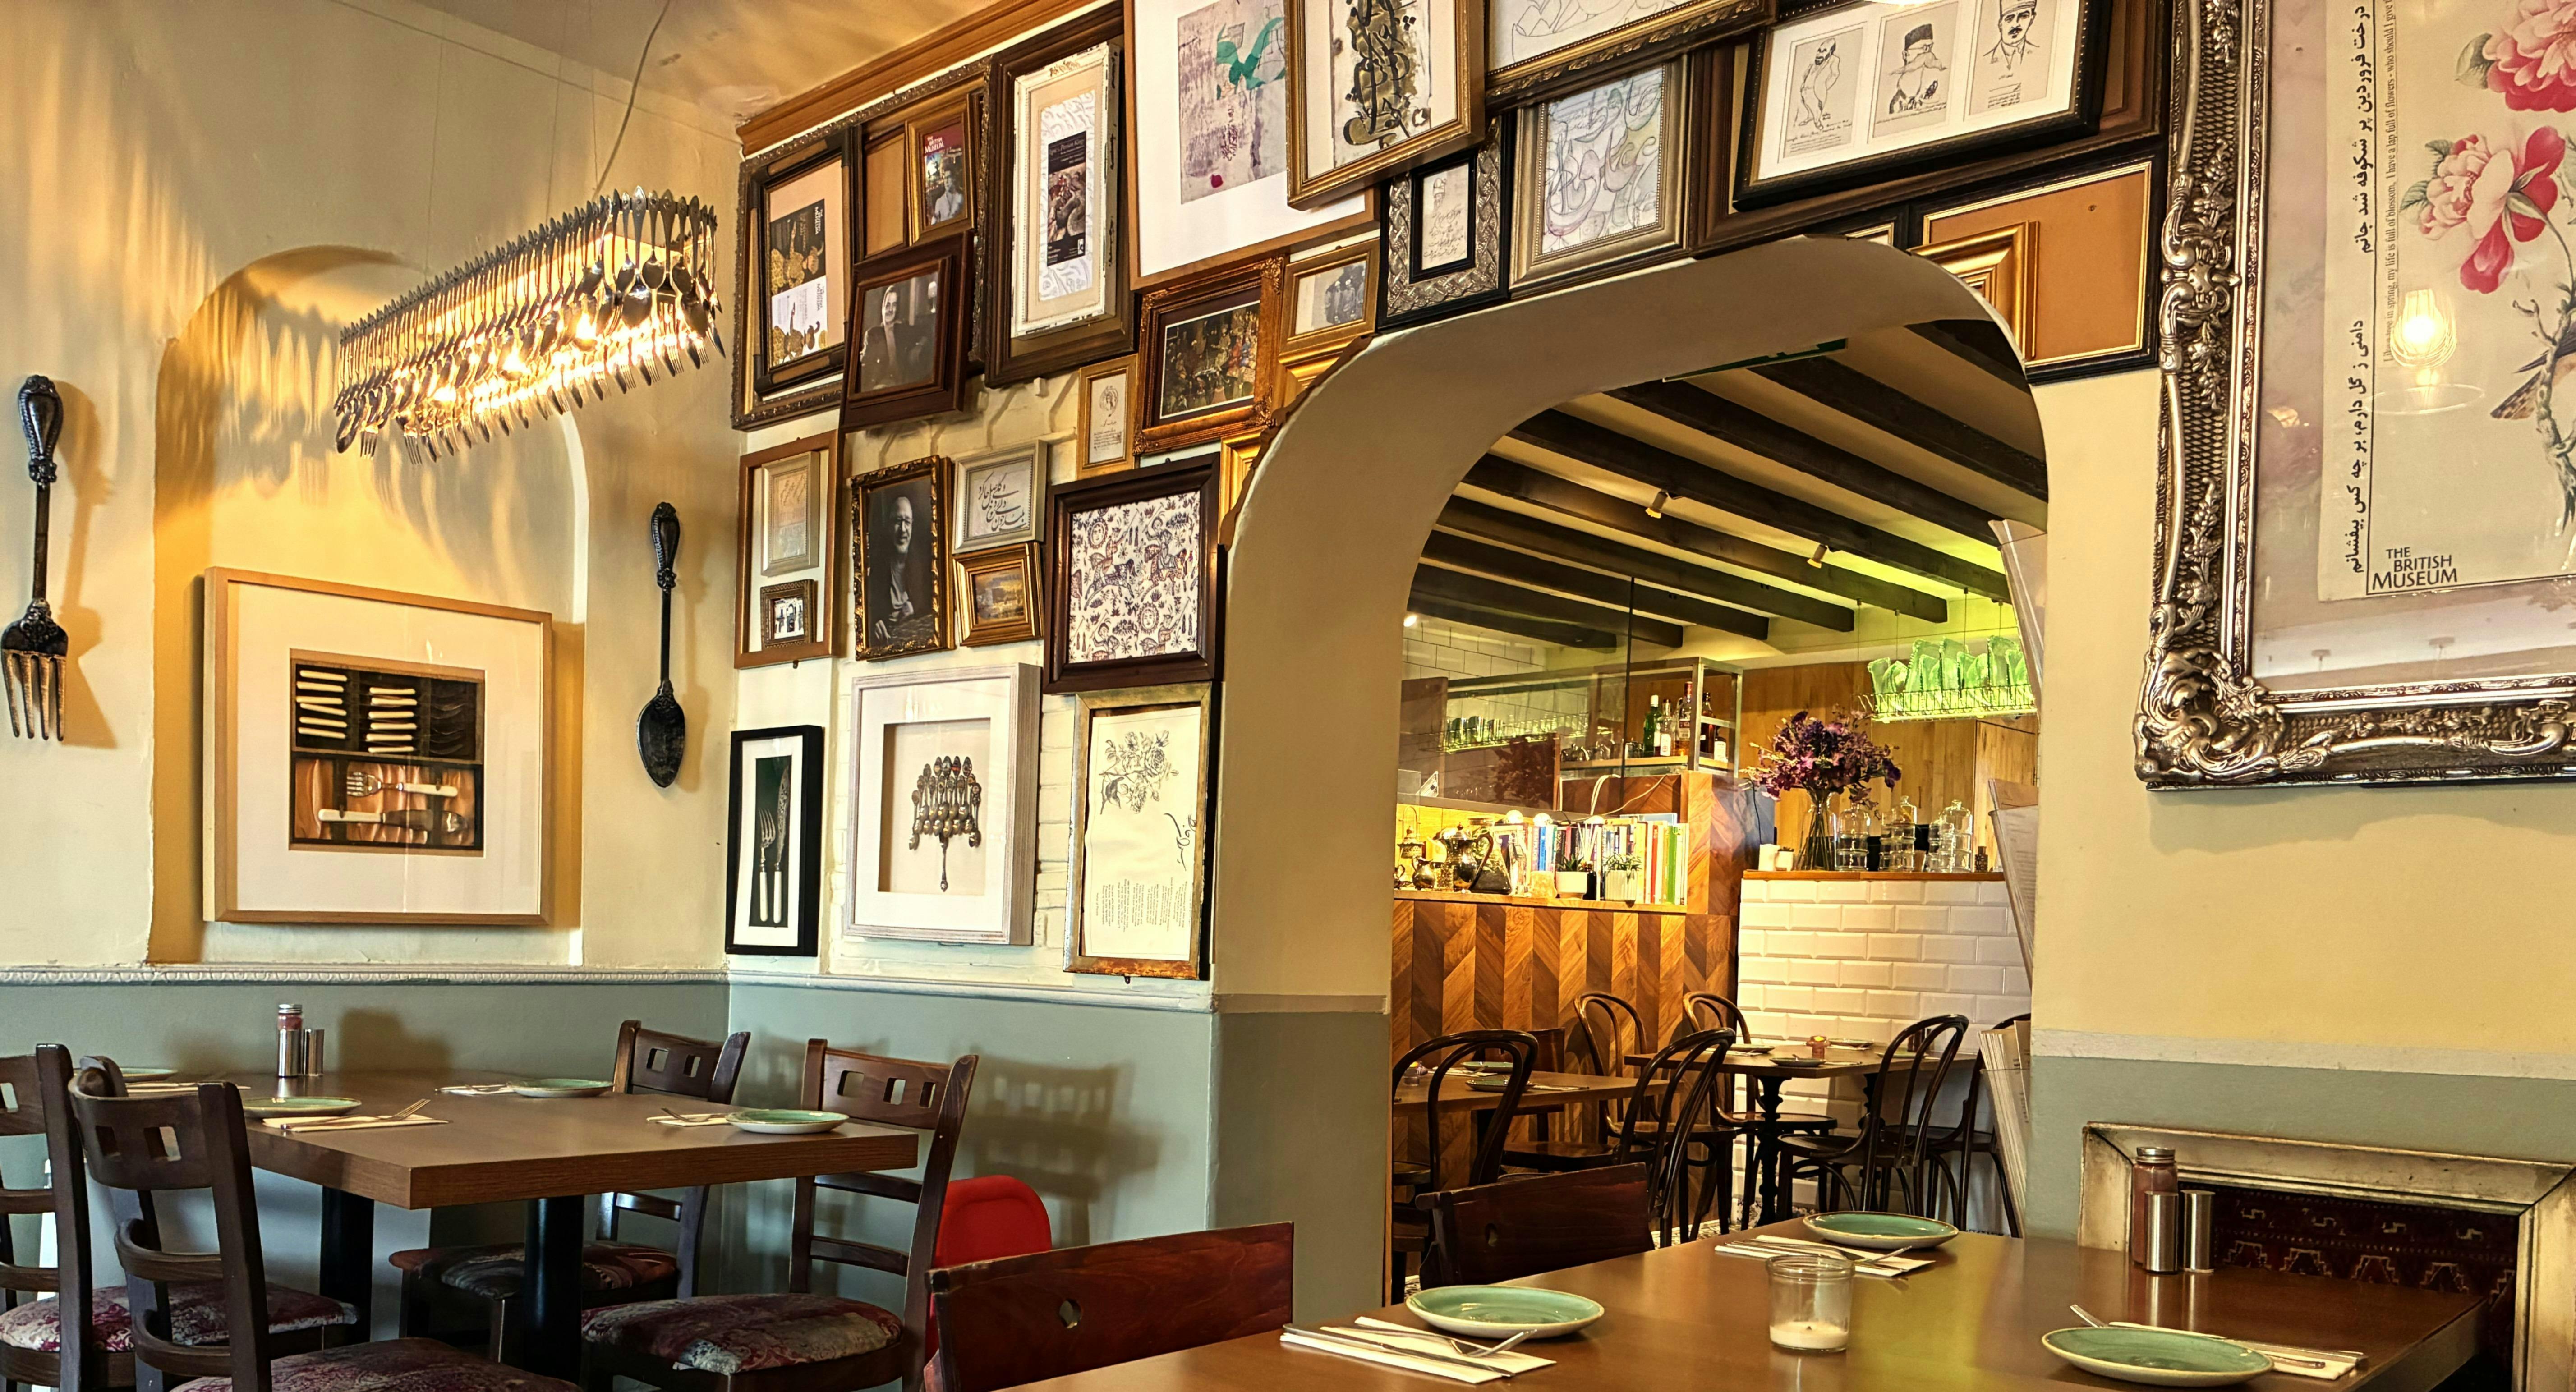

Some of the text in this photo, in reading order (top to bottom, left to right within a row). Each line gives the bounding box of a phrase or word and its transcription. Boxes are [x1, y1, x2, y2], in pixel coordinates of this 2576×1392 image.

[2383, 5, 2396, 21] give
[2383, 28, 2394, 53] should
[2384, 55, 2394, 72] who
[2385, 79, 2396, 107] flowers
[2385, 109, 2395, 118] of
[2351, 6, 2374, 253] درخت فروردین پر شکوفه شد جانم
[2385, 120, 2395, 133] full
[2386, 135, 2397, 147] lap
[2385, 155, 2396, 174] have
[2385, 218, 2396, 227] of
[2385, 229, 2396, 242] full
[2385, 253, 2395, 266] life
[2387, 268, 2398, 280] my
[2385, 282, 2398, 308] spring,
[2349, 320, 2369, 357] دامنی
[2348, 377, 2367, 395] گل
[2353, 441, 2367, 453] بر
[2351, 459, 2367, 478] چه
[2346, 485, 2366, 514] کس
[2344, 519, 2364, 573] بیفشانم
[2386, 547, 2411, 559] THE
[2394, 554, 2452, 573] BRITISH
[2372, 568, 2457, 591] MUSEUM
